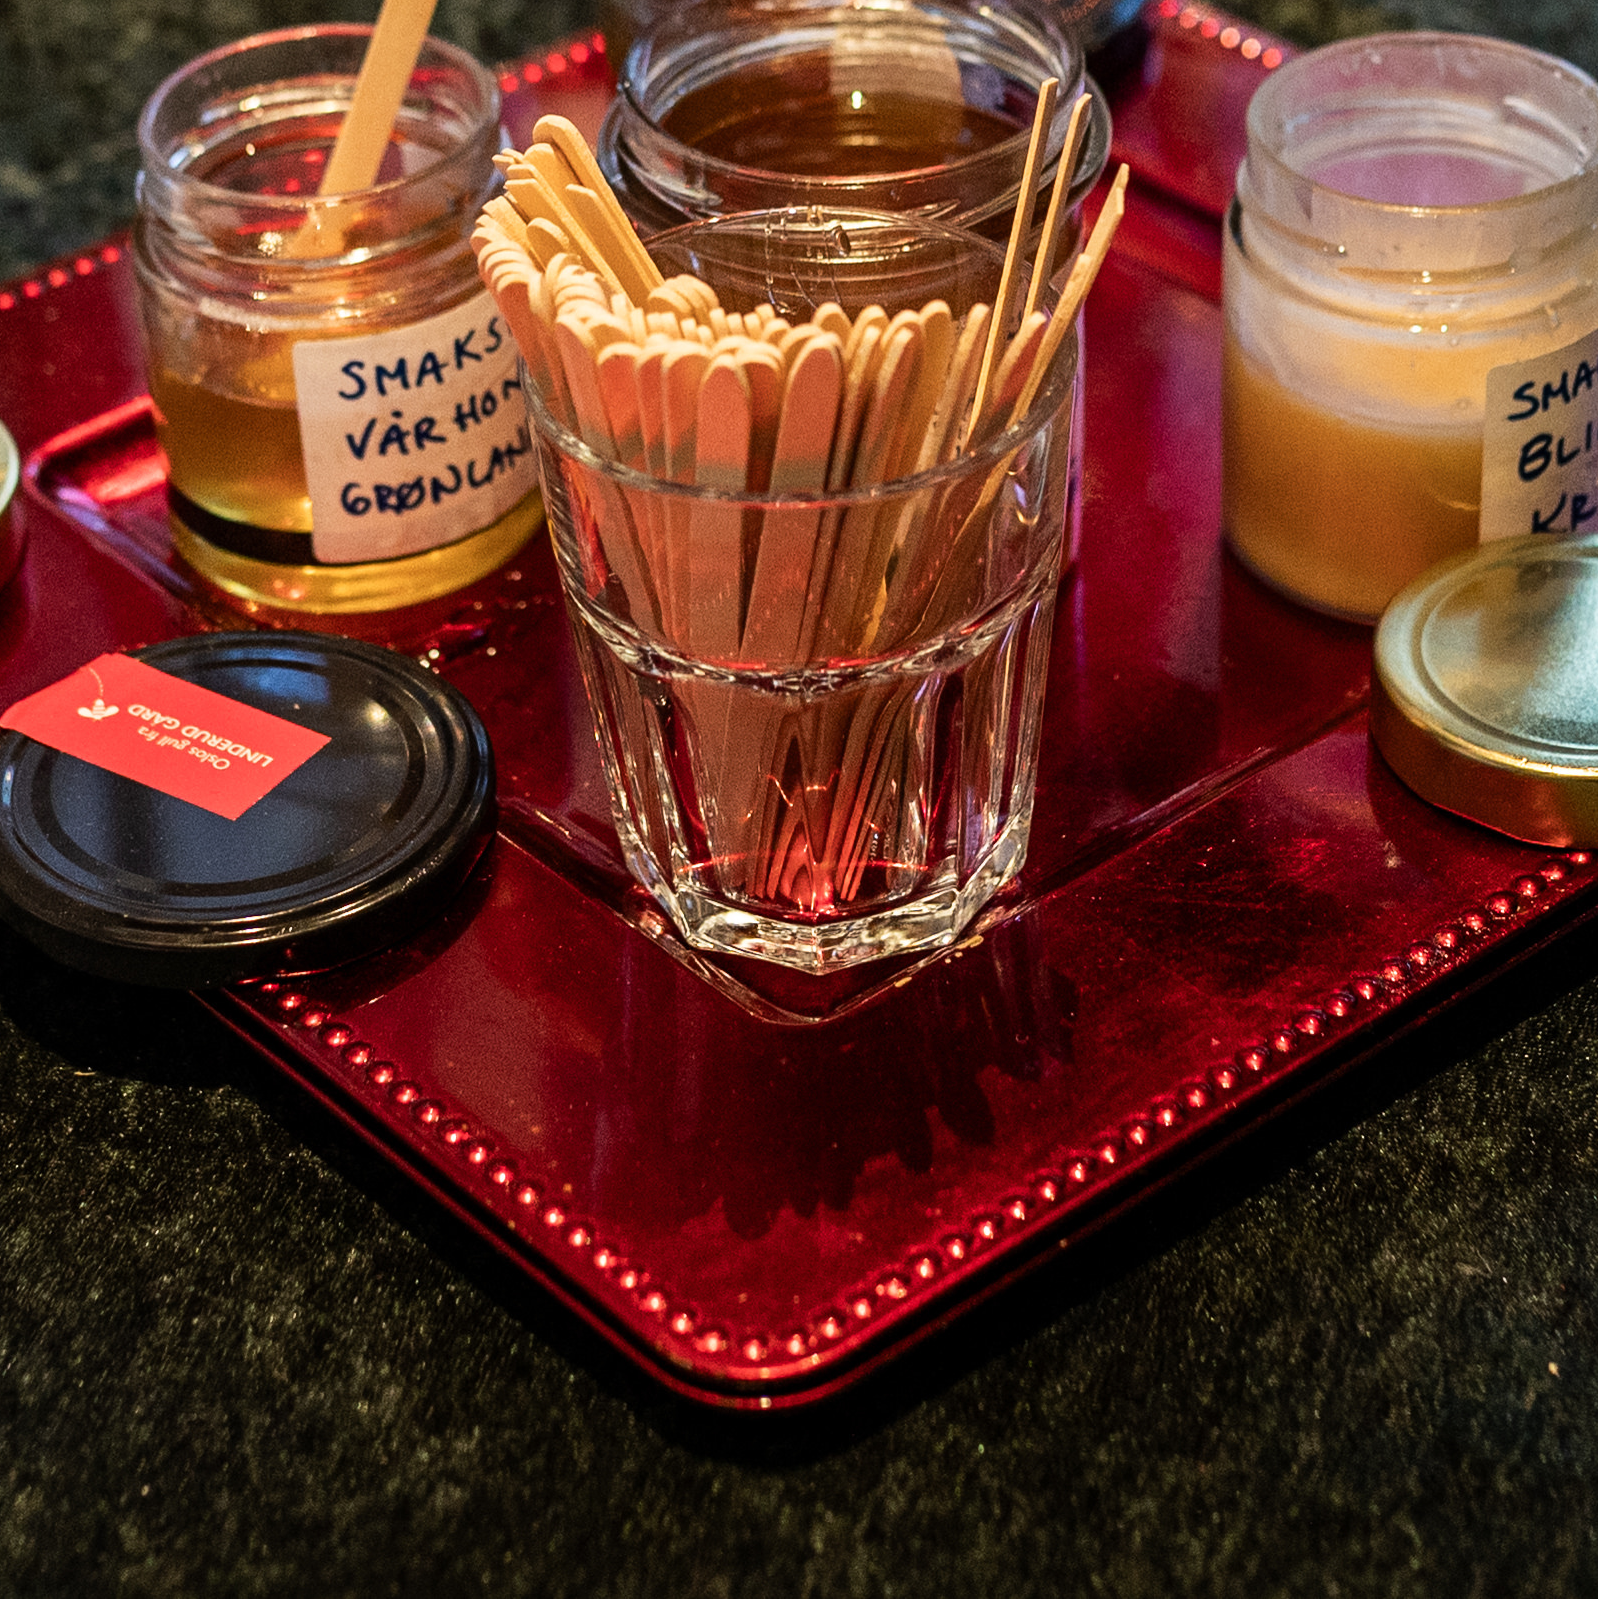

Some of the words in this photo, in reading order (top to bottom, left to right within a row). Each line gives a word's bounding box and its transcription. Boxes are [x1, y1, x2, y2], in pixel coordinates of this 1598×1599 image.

[338, 316, 512, 400] SMAKS
[345, 410, 447, 460] VÅR
[127, 704, 181, 730] GÅRD
[137, 726, 160, 742] fra
[156, 735, 191, 751] gull
[180, 725, 274, 768] LINDERUD
[188, 746, 231, 771] Oslos
